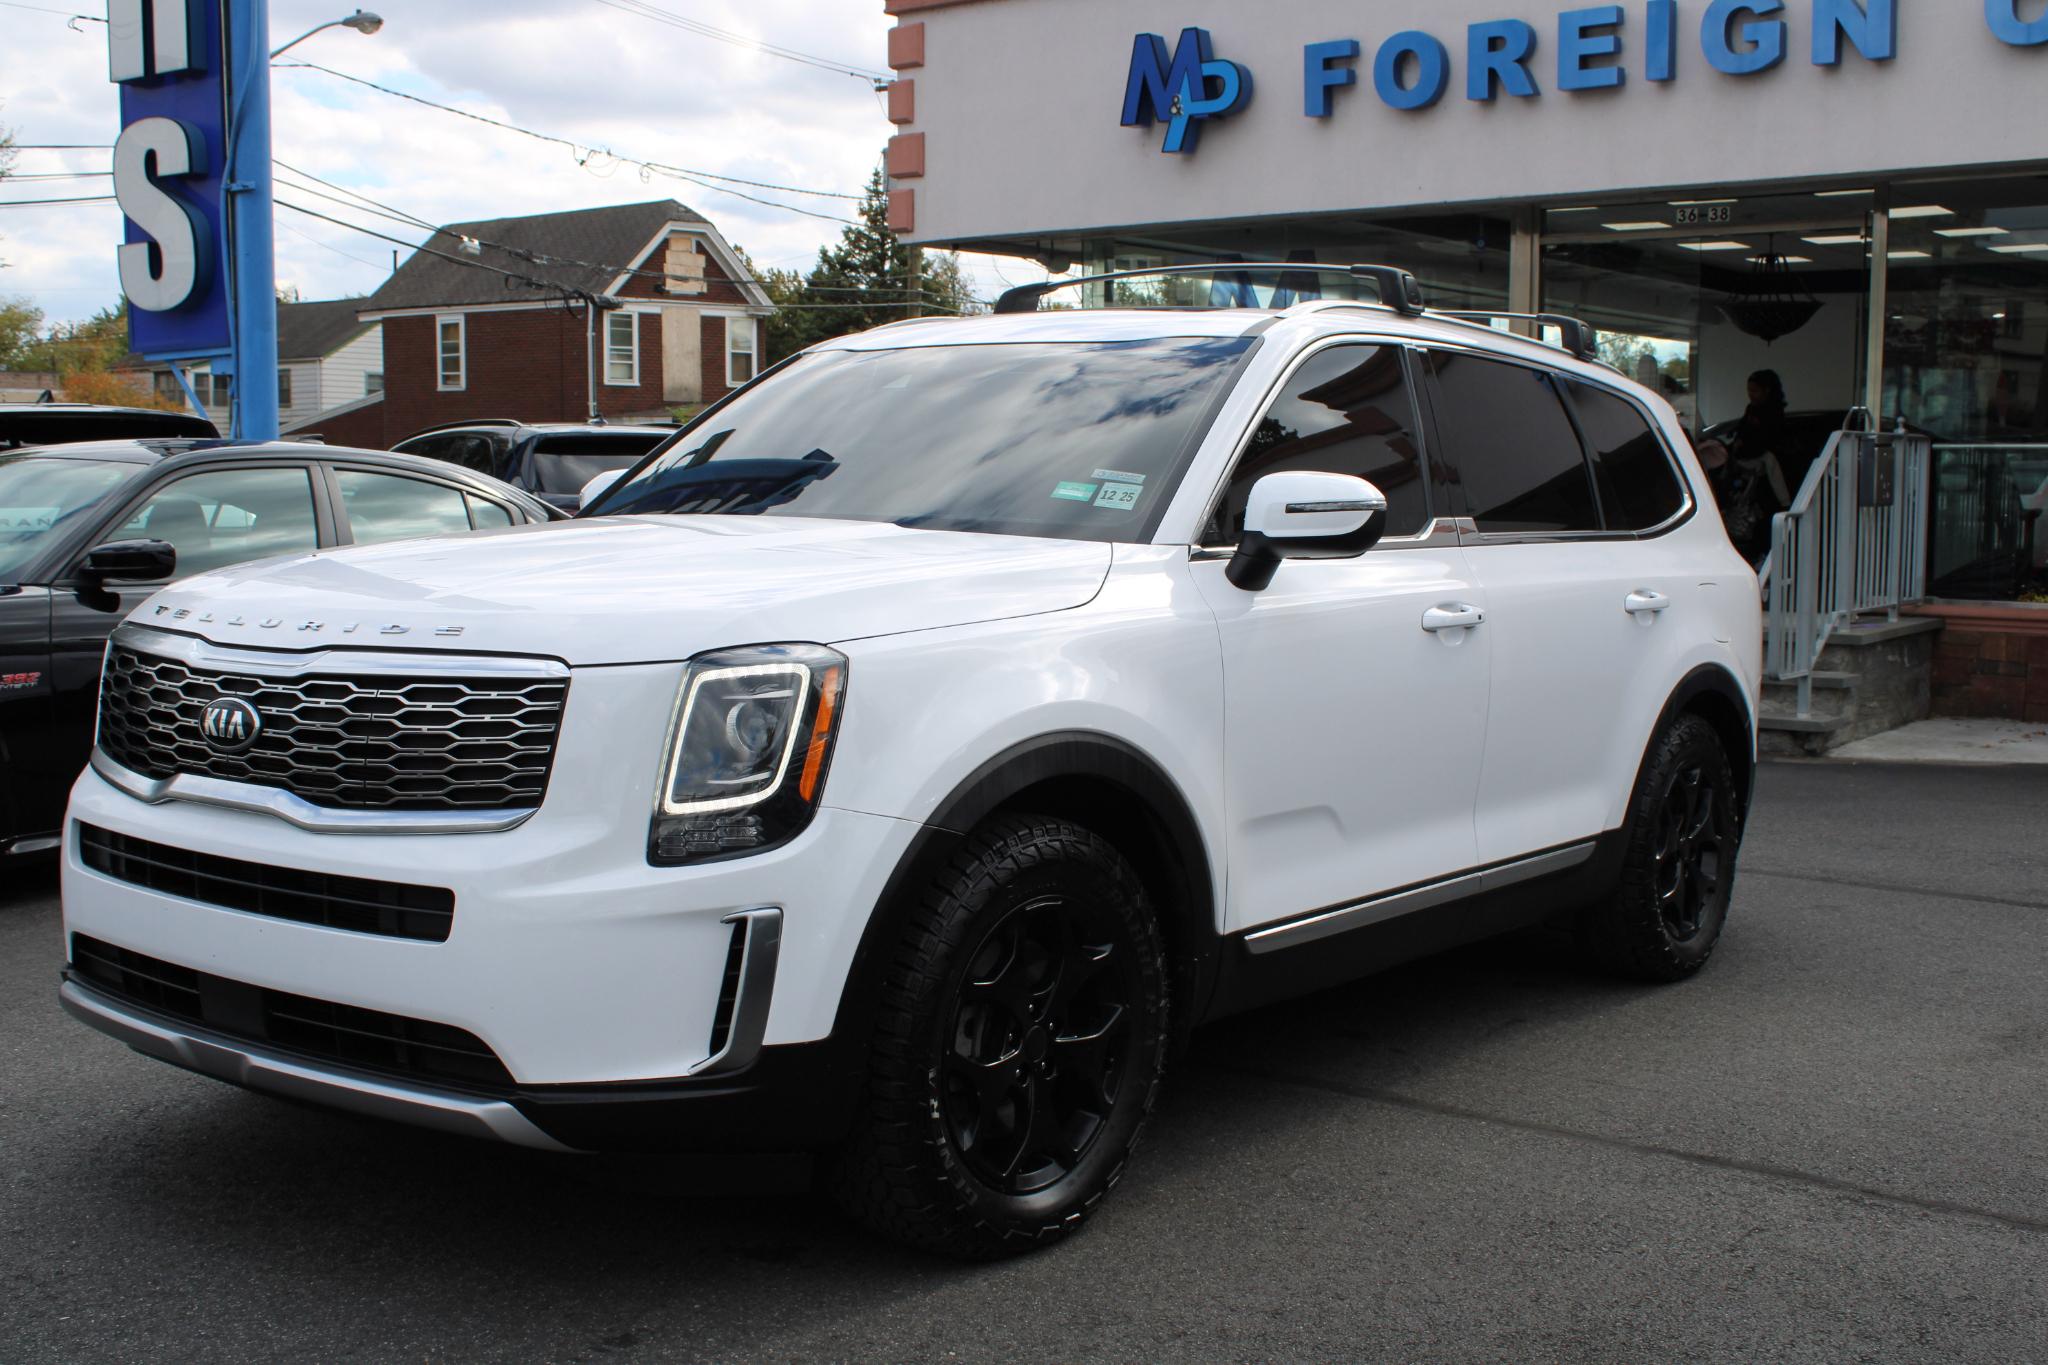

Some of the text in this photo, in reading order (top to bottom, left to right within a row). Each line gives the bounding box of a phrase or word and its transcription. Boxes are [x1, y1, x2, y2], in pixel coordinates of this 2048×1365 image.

[1303, 0, 1897, 118] FOREIGN
[1678, 207, 1730, 223] 36-38
[1100, 489, 1117, 501] 12
[1118, 491, 1135, 502] 25
[154, 604, 465, 637] TELLURIDE
[204, 707, 246, 740] KIA
